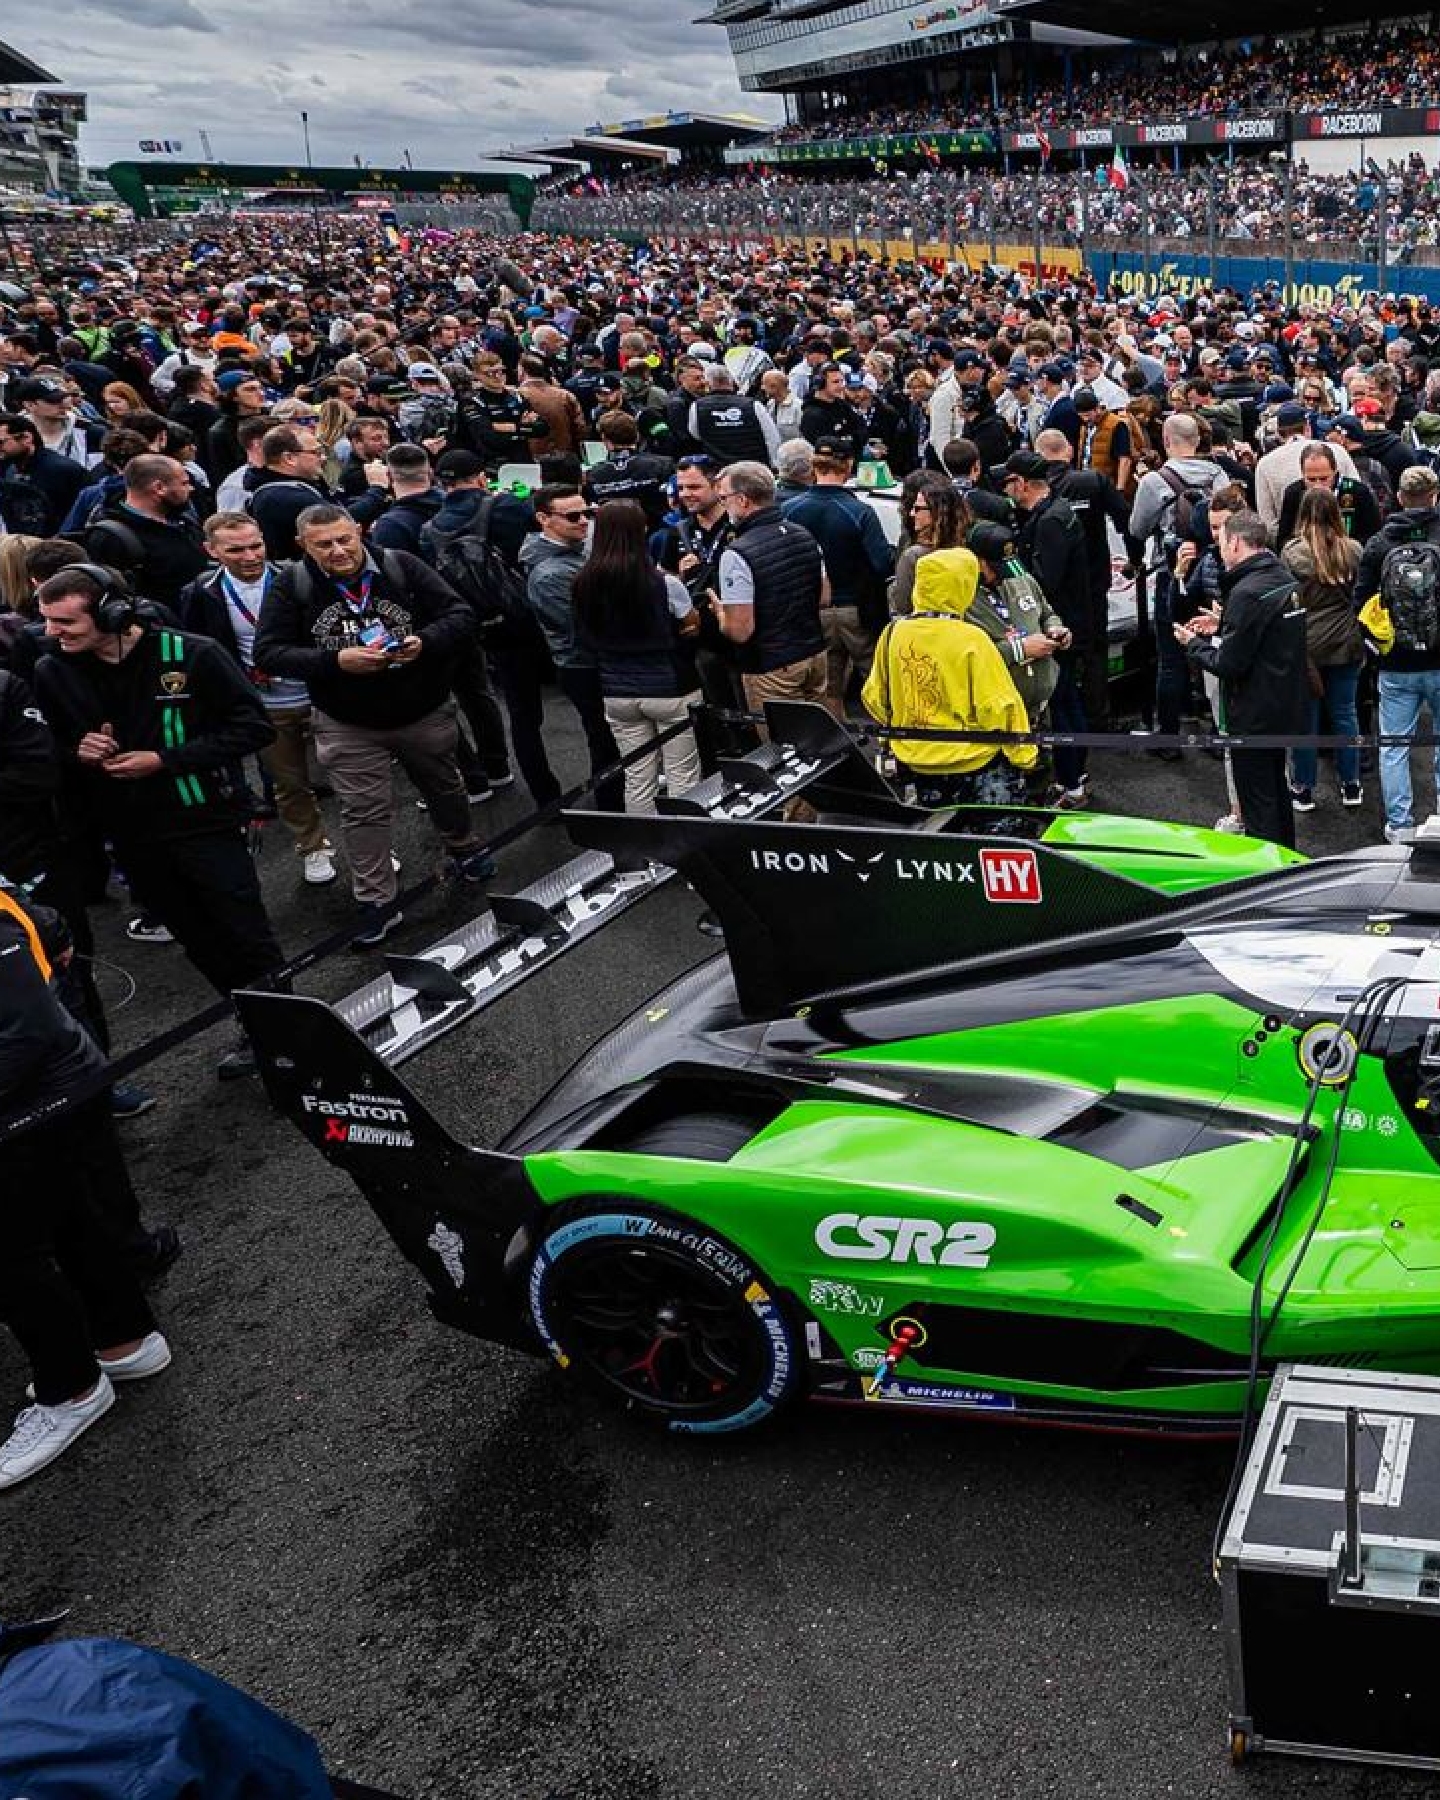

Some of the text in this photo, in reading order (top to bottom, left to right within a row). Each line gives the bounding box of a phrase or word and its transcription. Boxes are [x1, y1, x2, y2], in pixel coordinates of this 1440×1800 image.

[1225, 119, 1275, 139] RACEBORN
[1322, 113, 1381, 133] RACEBORN
[1076, 129, 1112, 145] RACEBORN
[1146, 125, 1188, 142] RACEBORN
[750, 849, 976, 884] IRON LYNX
[985, 858, 1032, 892] HY
[302, 1094, 409, 1123] Fastron
[625, 1219, 648, 1233] W
[814, 1213, 997, 1269] CSR2
[764, 1318, 790, 1398] MICHELIN
[906, 1386, 995, 1401] MICHELIN
